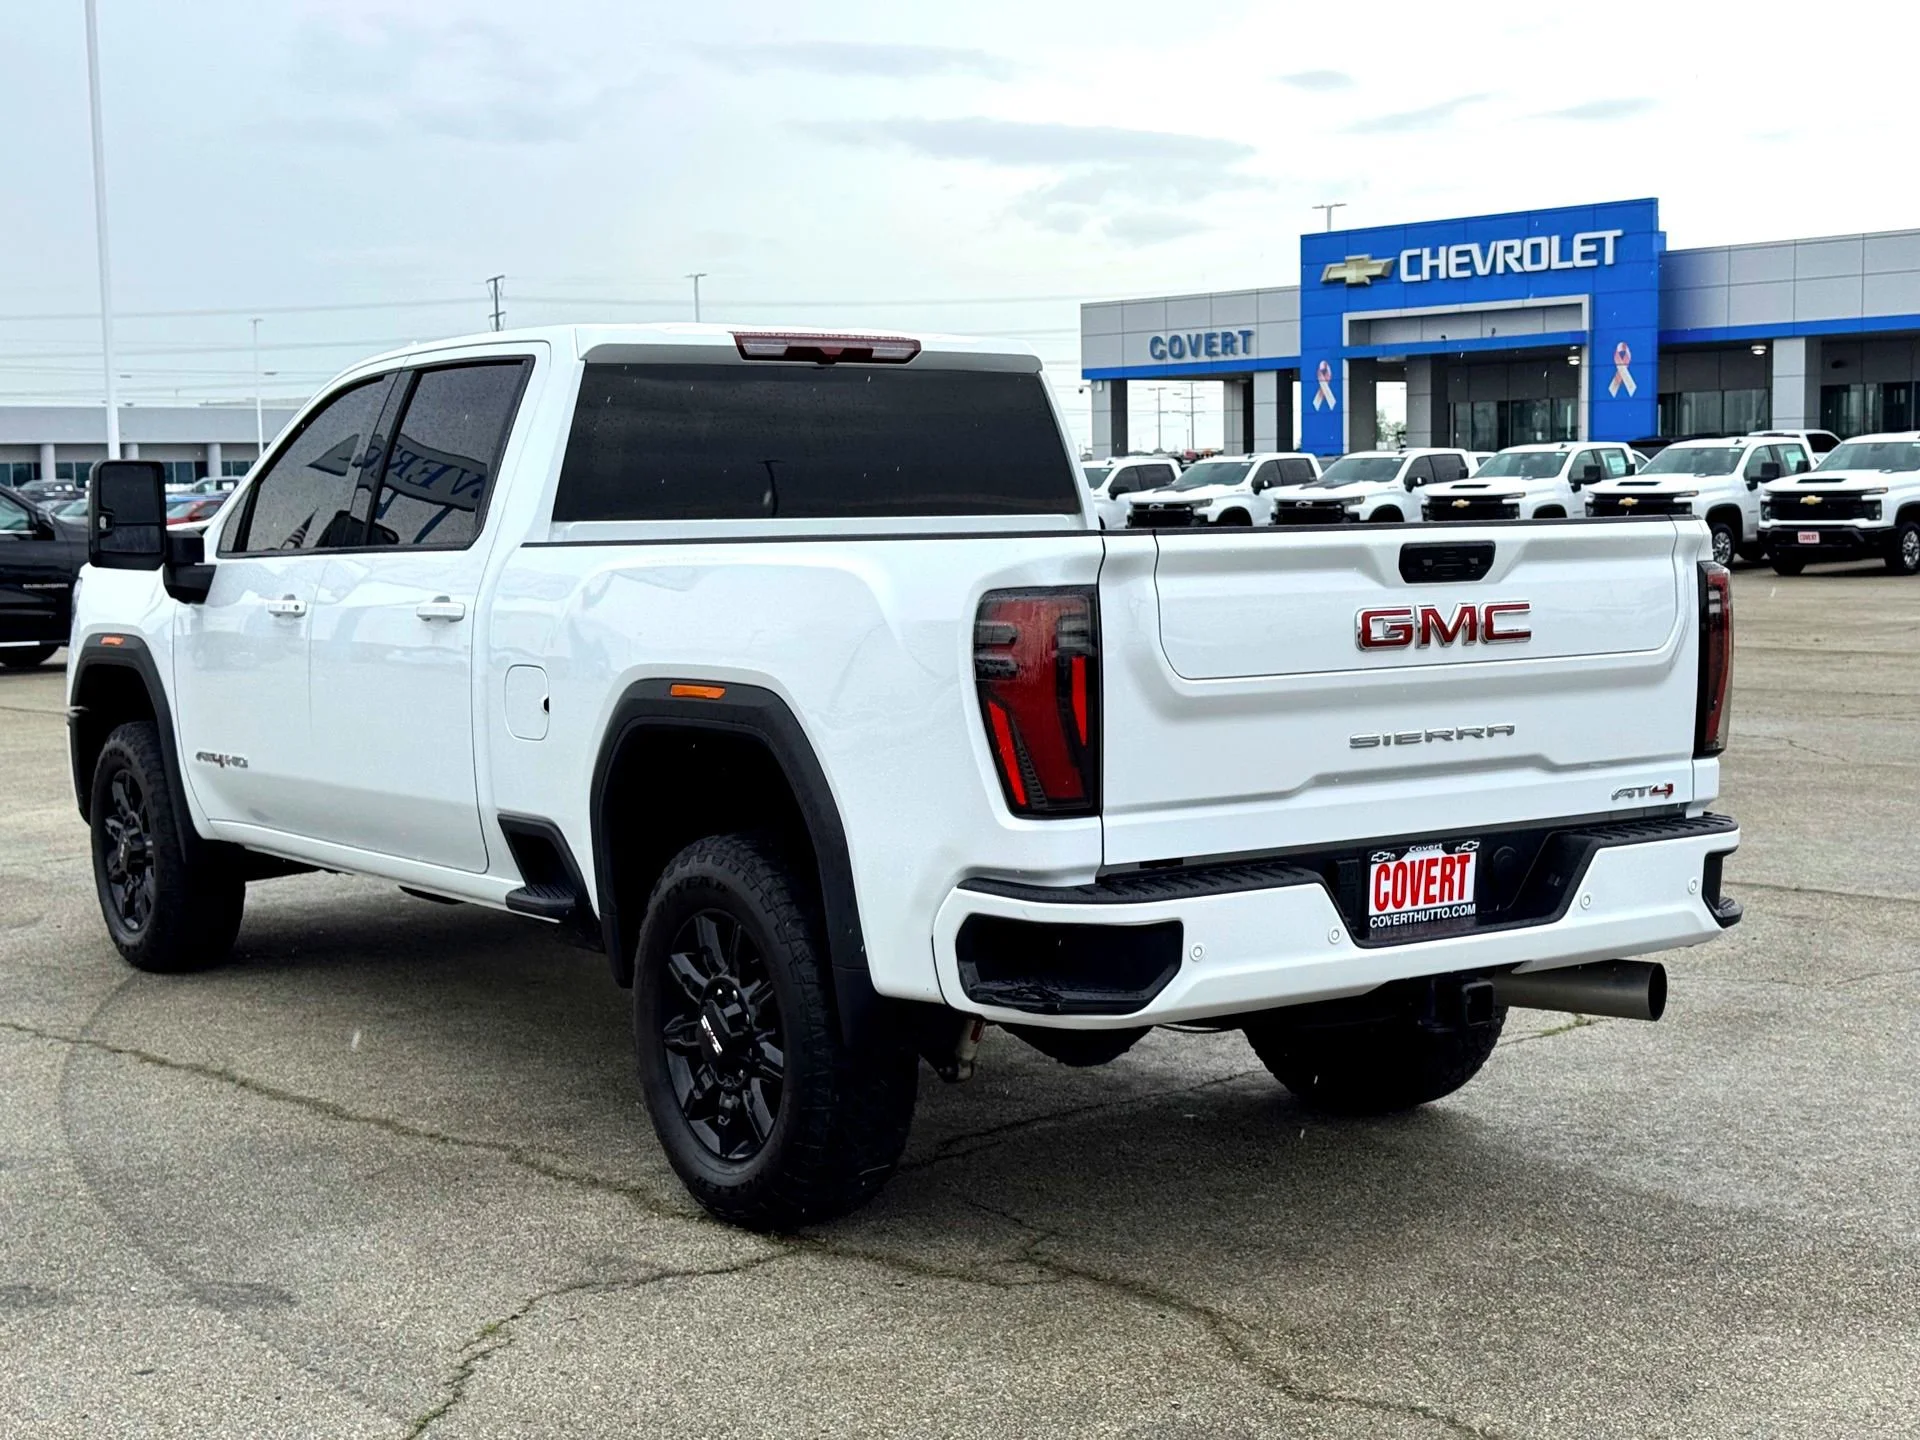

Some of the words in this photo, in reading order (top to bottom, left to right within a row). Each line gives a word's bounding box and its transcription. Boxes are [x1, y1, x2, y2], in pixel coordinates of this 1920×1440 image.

[1399, 230, 1624, 283] CHEVROLET
[1150, 330, 1255, 360] COVERT
[1355, 601, 1531, 650] GMC
[1349, 724, 1515, 748] SIERRA
[1611, 783, 1674, 801] AT4
[1409, 843, 1443, 853] Covert
[1374, 854, 1471, 912] COVERT
[1369, 903, 1476, 929] COVERTHUTTO.COM
